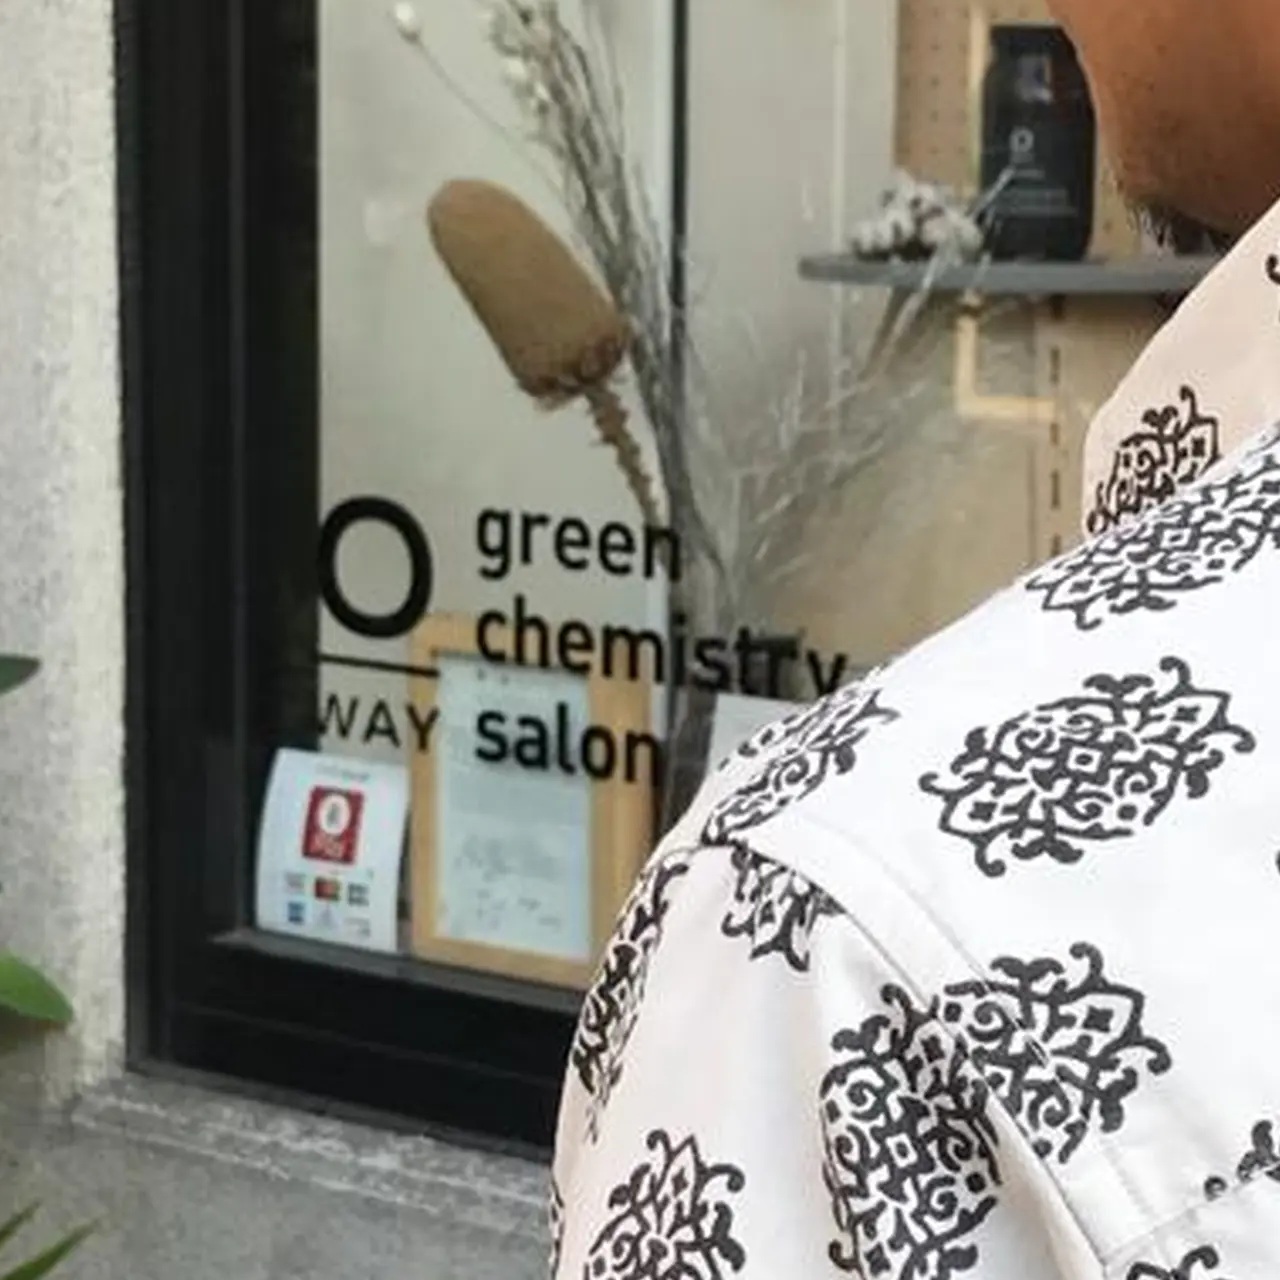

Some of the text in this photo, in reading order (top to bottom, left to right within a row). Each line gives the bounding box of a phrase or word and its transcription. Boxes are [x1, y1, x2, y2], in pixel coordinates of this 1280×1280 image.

[475, 506, 681, 581] green
[475, 595, 848, 702] chemistry
[474, 702, 664, 796] salon
